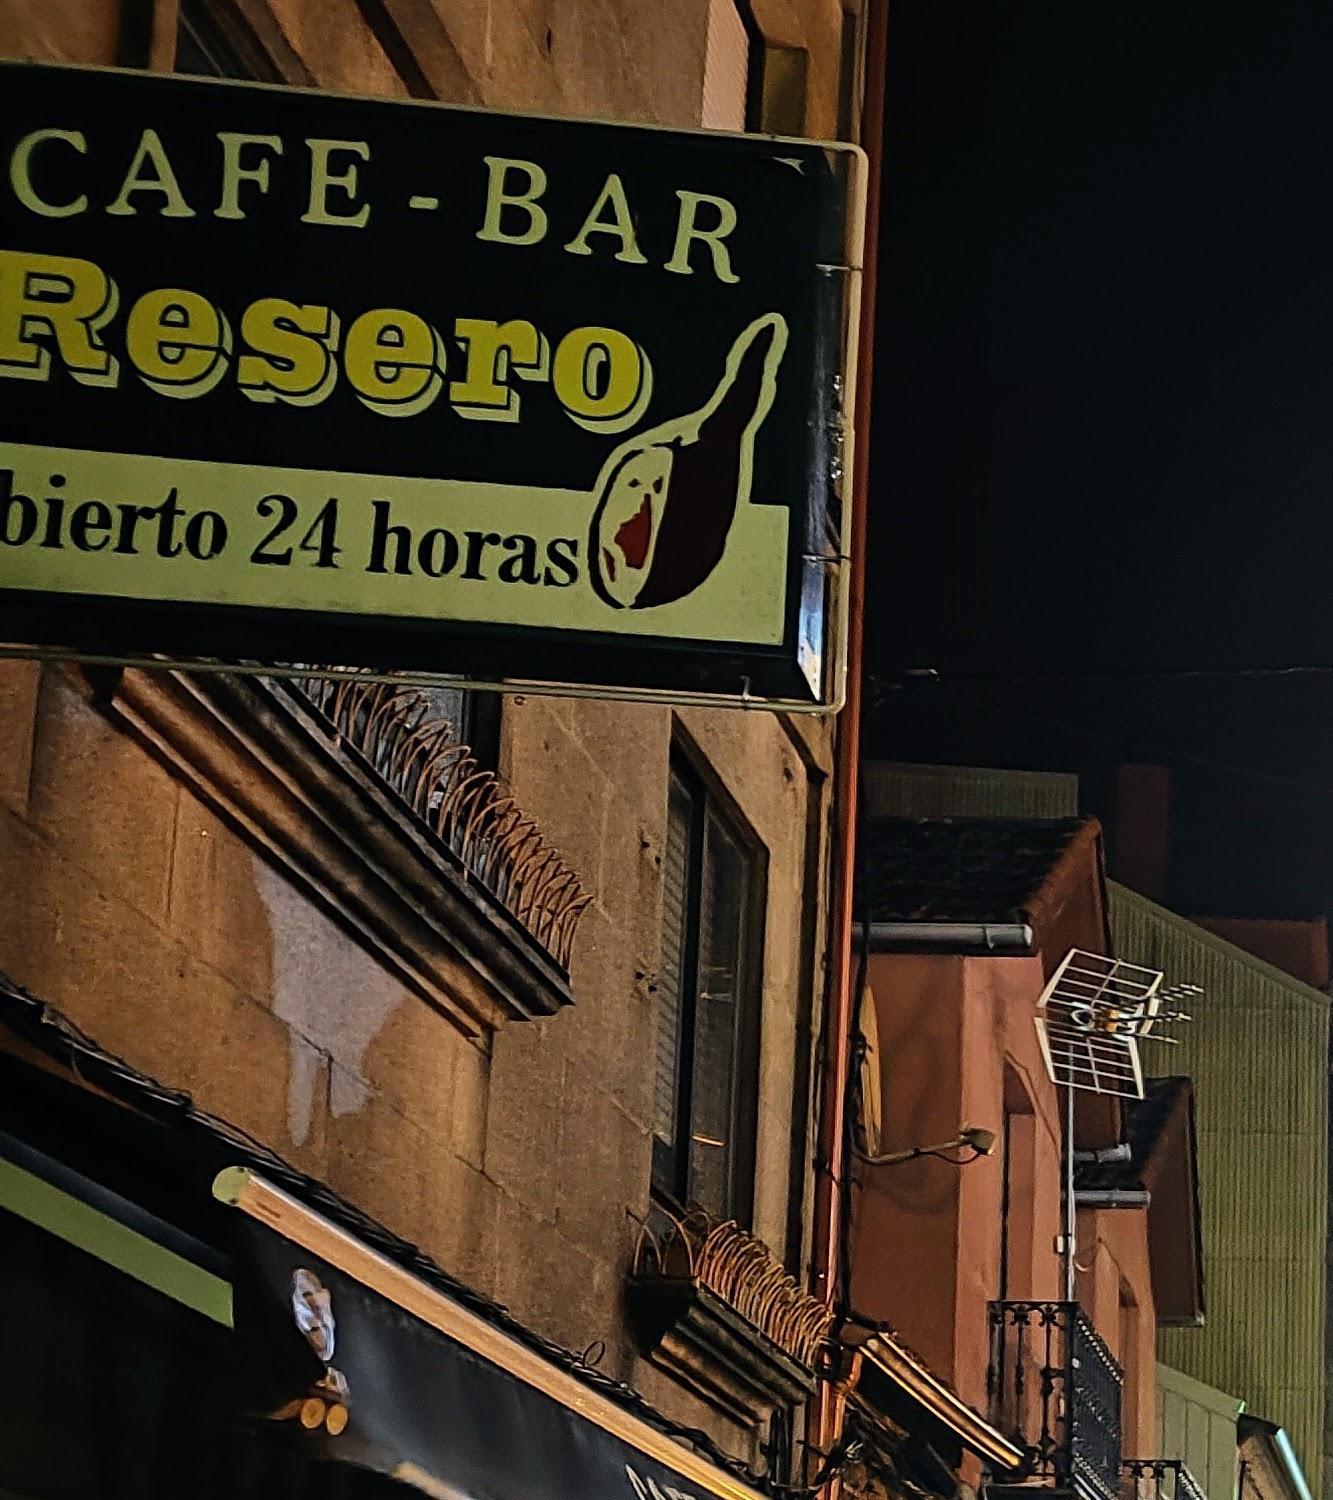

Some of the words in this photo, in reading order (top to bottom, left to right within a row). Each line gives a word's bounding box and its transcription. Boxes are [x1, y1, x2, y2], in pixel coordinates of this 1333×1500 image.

[0, 249, 652, 433] Resero
[250, 494, 343, 568] 24
[366, 500, 578, 587] horas
